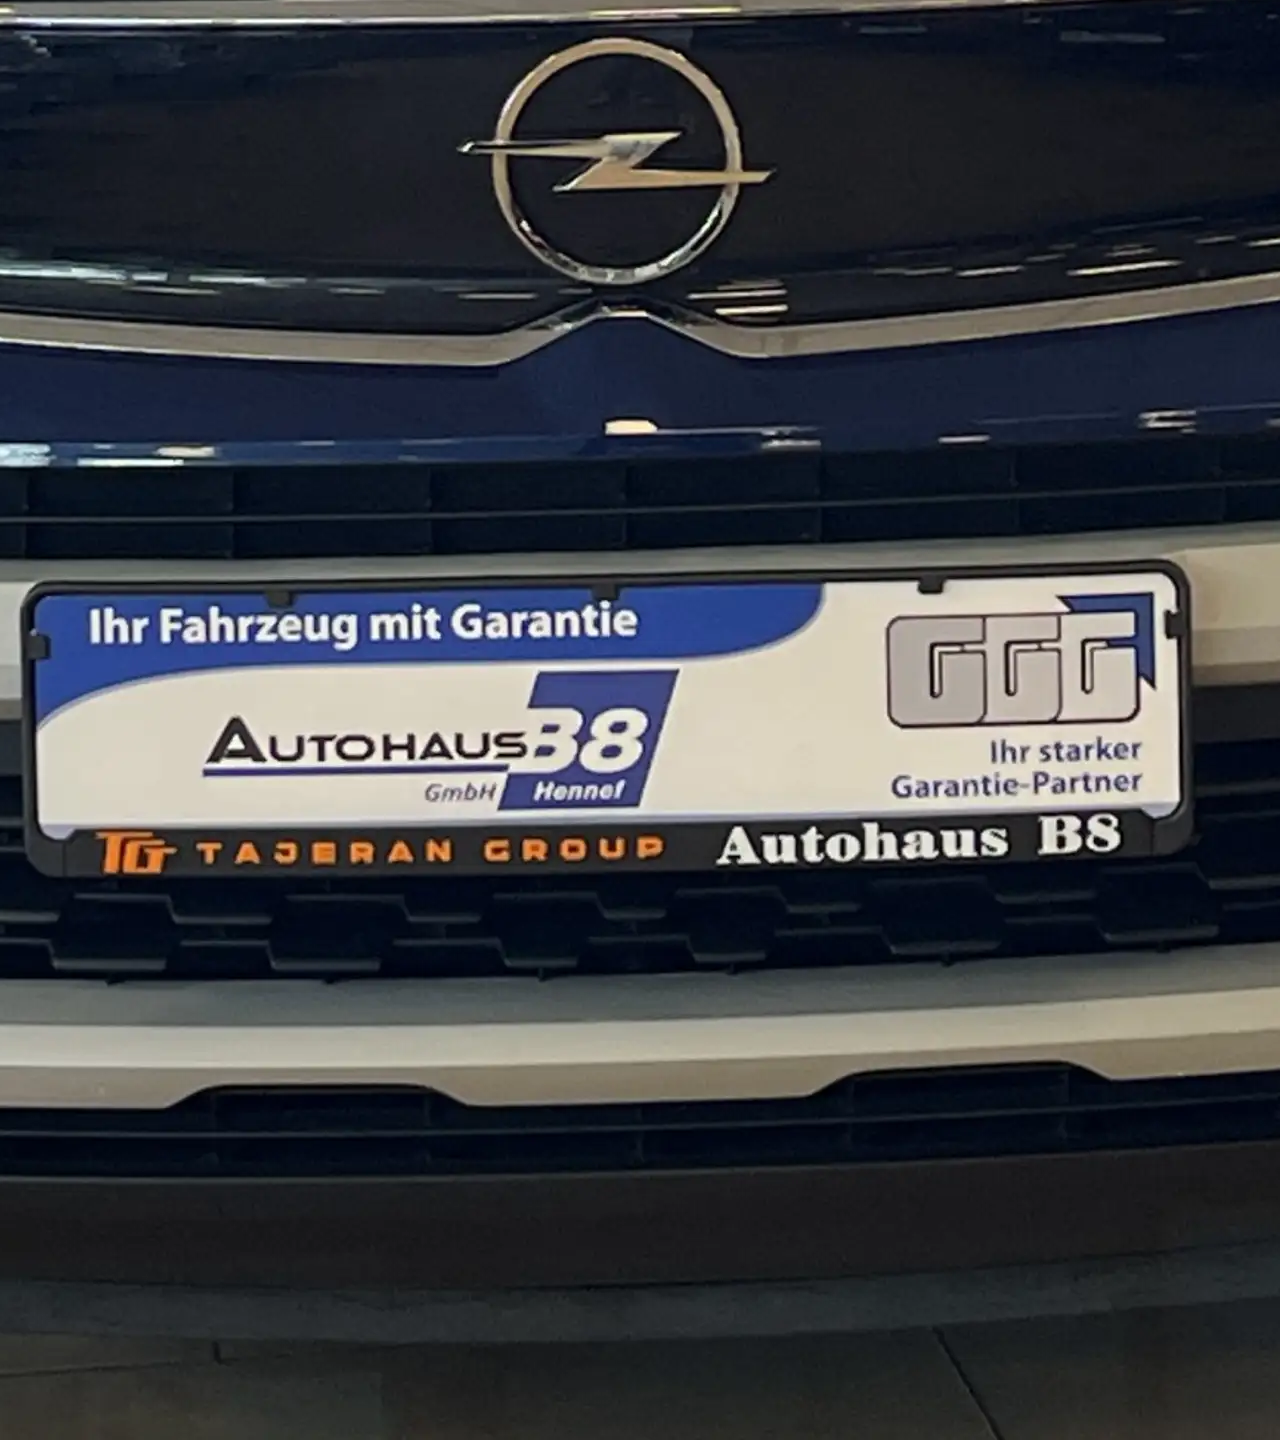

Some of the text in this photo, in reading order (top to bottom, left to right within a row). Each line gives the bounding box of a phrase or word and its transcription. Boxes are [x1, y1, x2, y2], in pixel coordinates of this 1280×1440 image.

[89, 600, 639, 650] Ihr Fahrzeug mit Garantie
[991, 737, 1143, 765] Ihr starker
[424, 782, 497, 803] GmbH
[533, 778, 626, 802] Hennef
[891, 770, 1143, 800] Garantie-Partner
[196, 835, 665, 866] TAJERAN GROUP
[716, 813, 1121, 866] Autohaus B8
